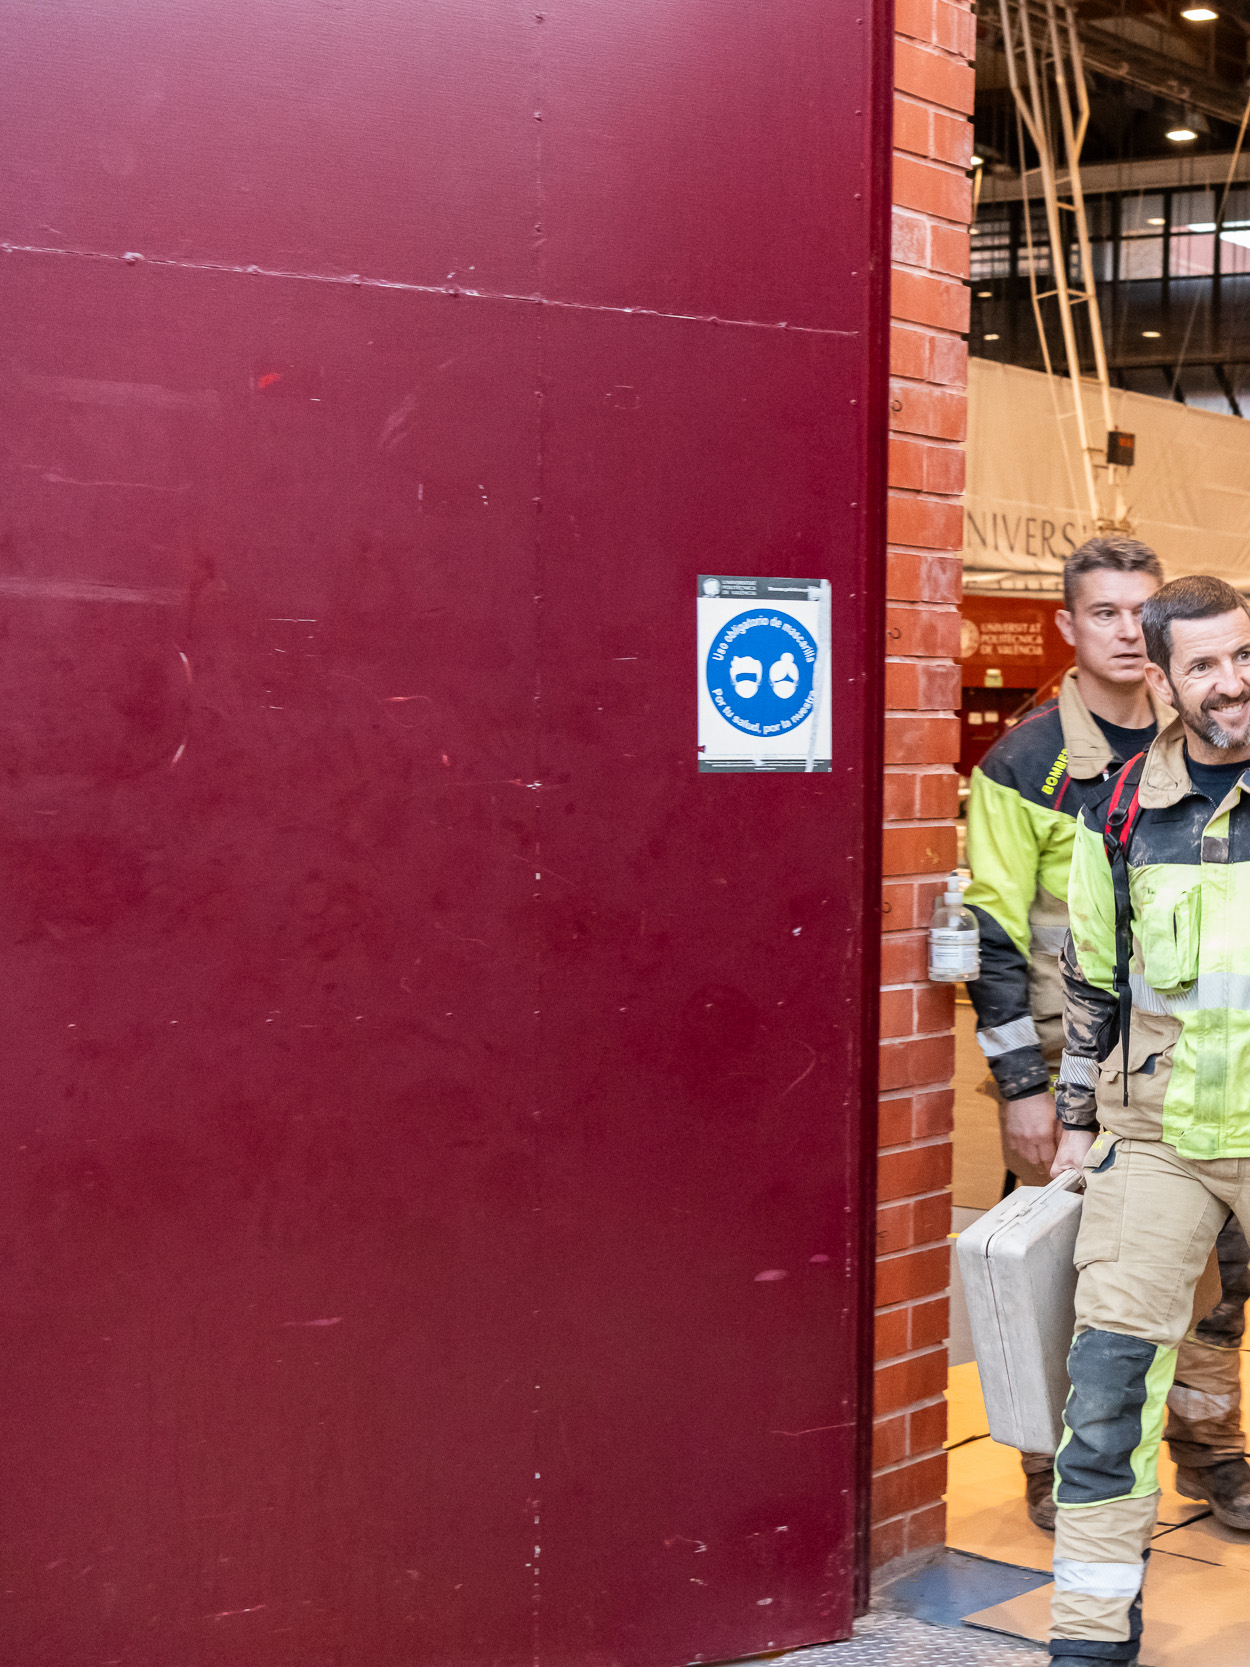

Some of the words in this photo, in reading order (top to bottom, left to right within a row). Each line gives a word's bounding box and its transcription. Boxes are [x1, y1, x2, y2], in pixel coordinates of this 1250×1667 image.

[966, 510, 1077, 561] NIVERS
[712, 643, 729, 660] Uso
[724, 615, 769, 642] obligatorio
[770, 617, 782, 628] de
[782, 623, 815, 662] mascarilla
[722, 706, 735, 718] tu
[732, 716, 761, 733] salud,
[763, 724, 780, 735] por
[780, 720, 792, 729] la
